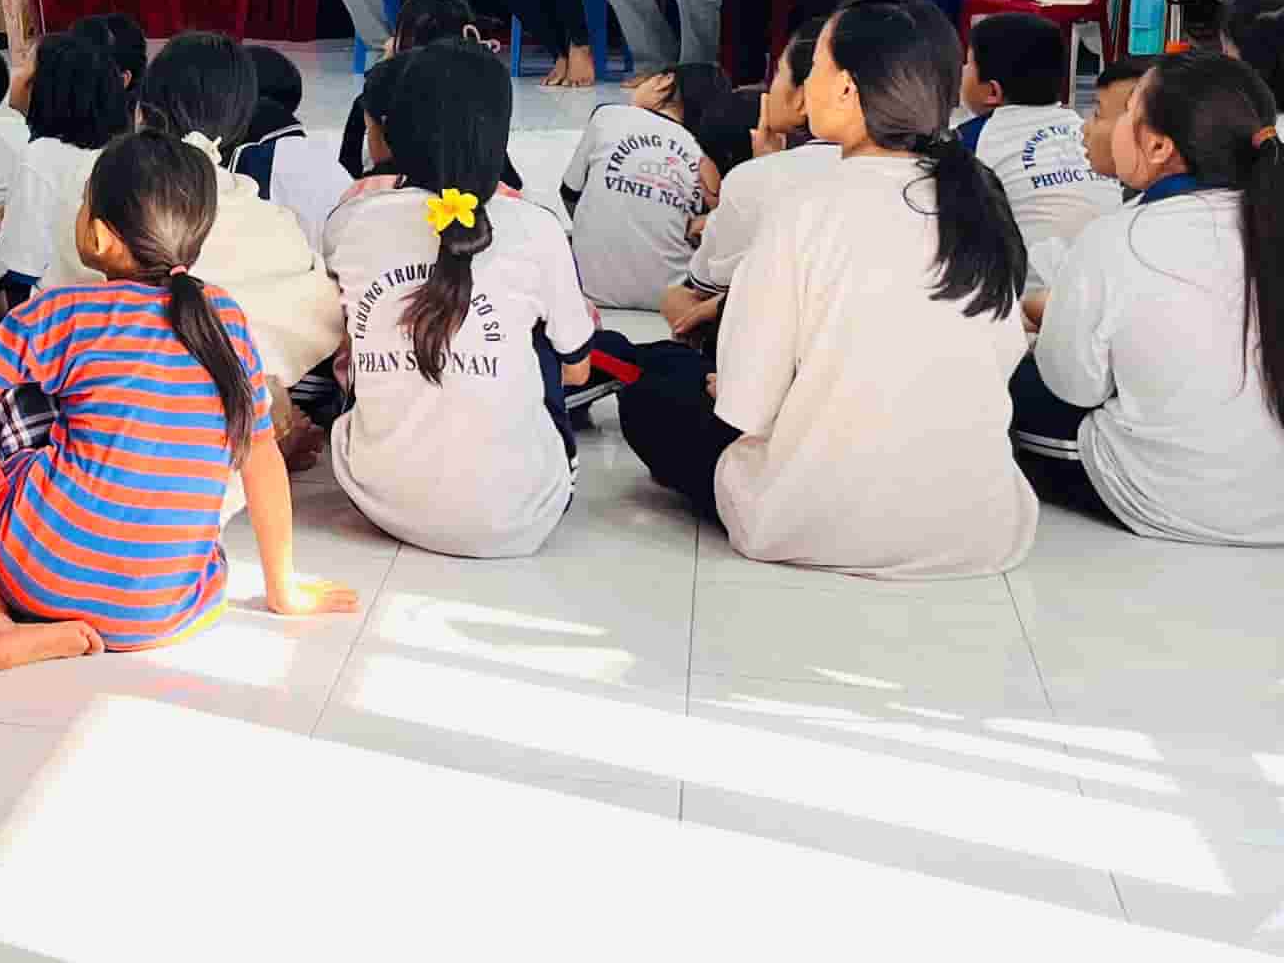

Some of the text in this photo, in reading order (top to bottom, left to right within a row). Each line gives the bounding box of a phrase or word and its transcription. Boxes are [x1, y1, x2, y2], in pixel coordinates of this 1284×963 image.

[358, 350, 499, 378] PHAN SO NAM
